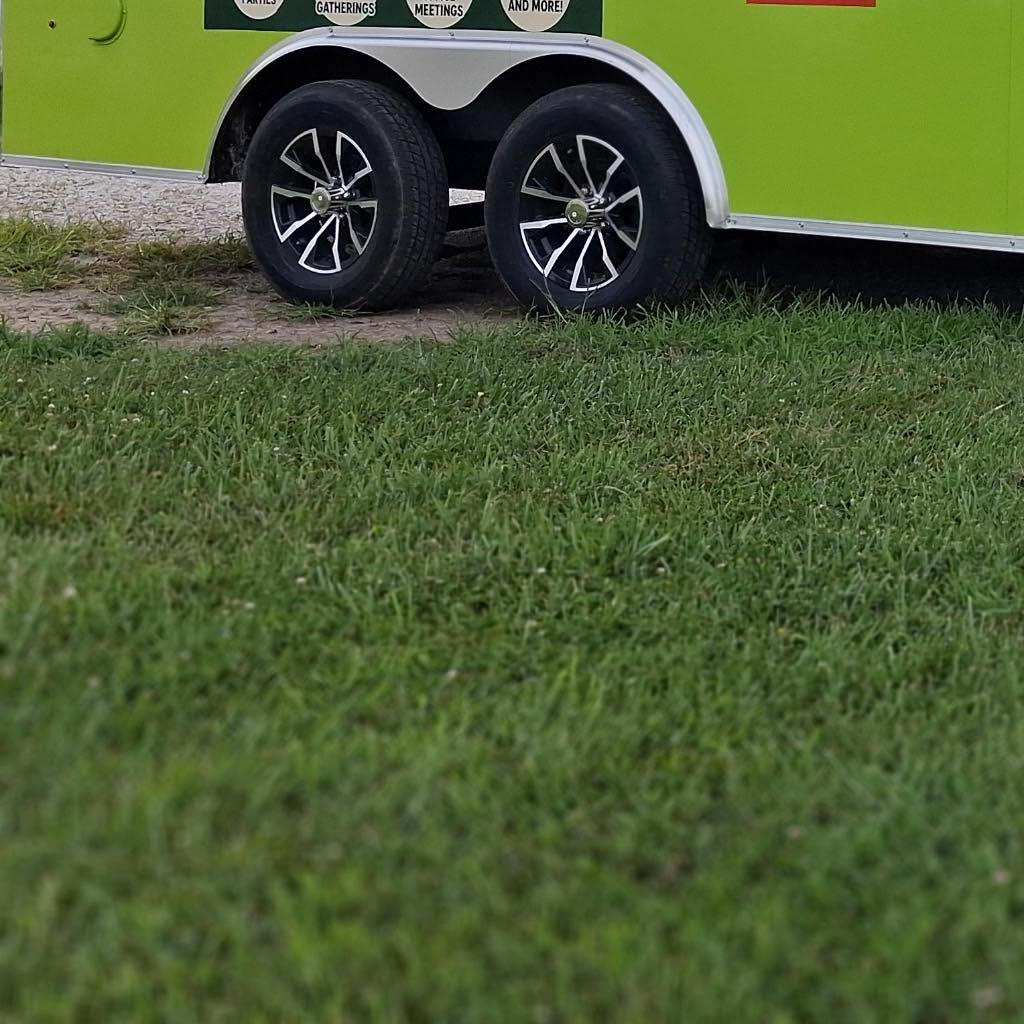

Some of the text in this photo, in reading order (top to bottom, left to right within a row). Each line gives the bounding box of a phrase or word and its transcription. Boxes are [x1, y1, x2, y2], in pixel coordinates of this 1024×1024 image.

[316, 1, 375, 15] GATHERINGS
[415, 4, 464, 17] MEETINGS
[508, 0, 563, 13] AND MORE!
